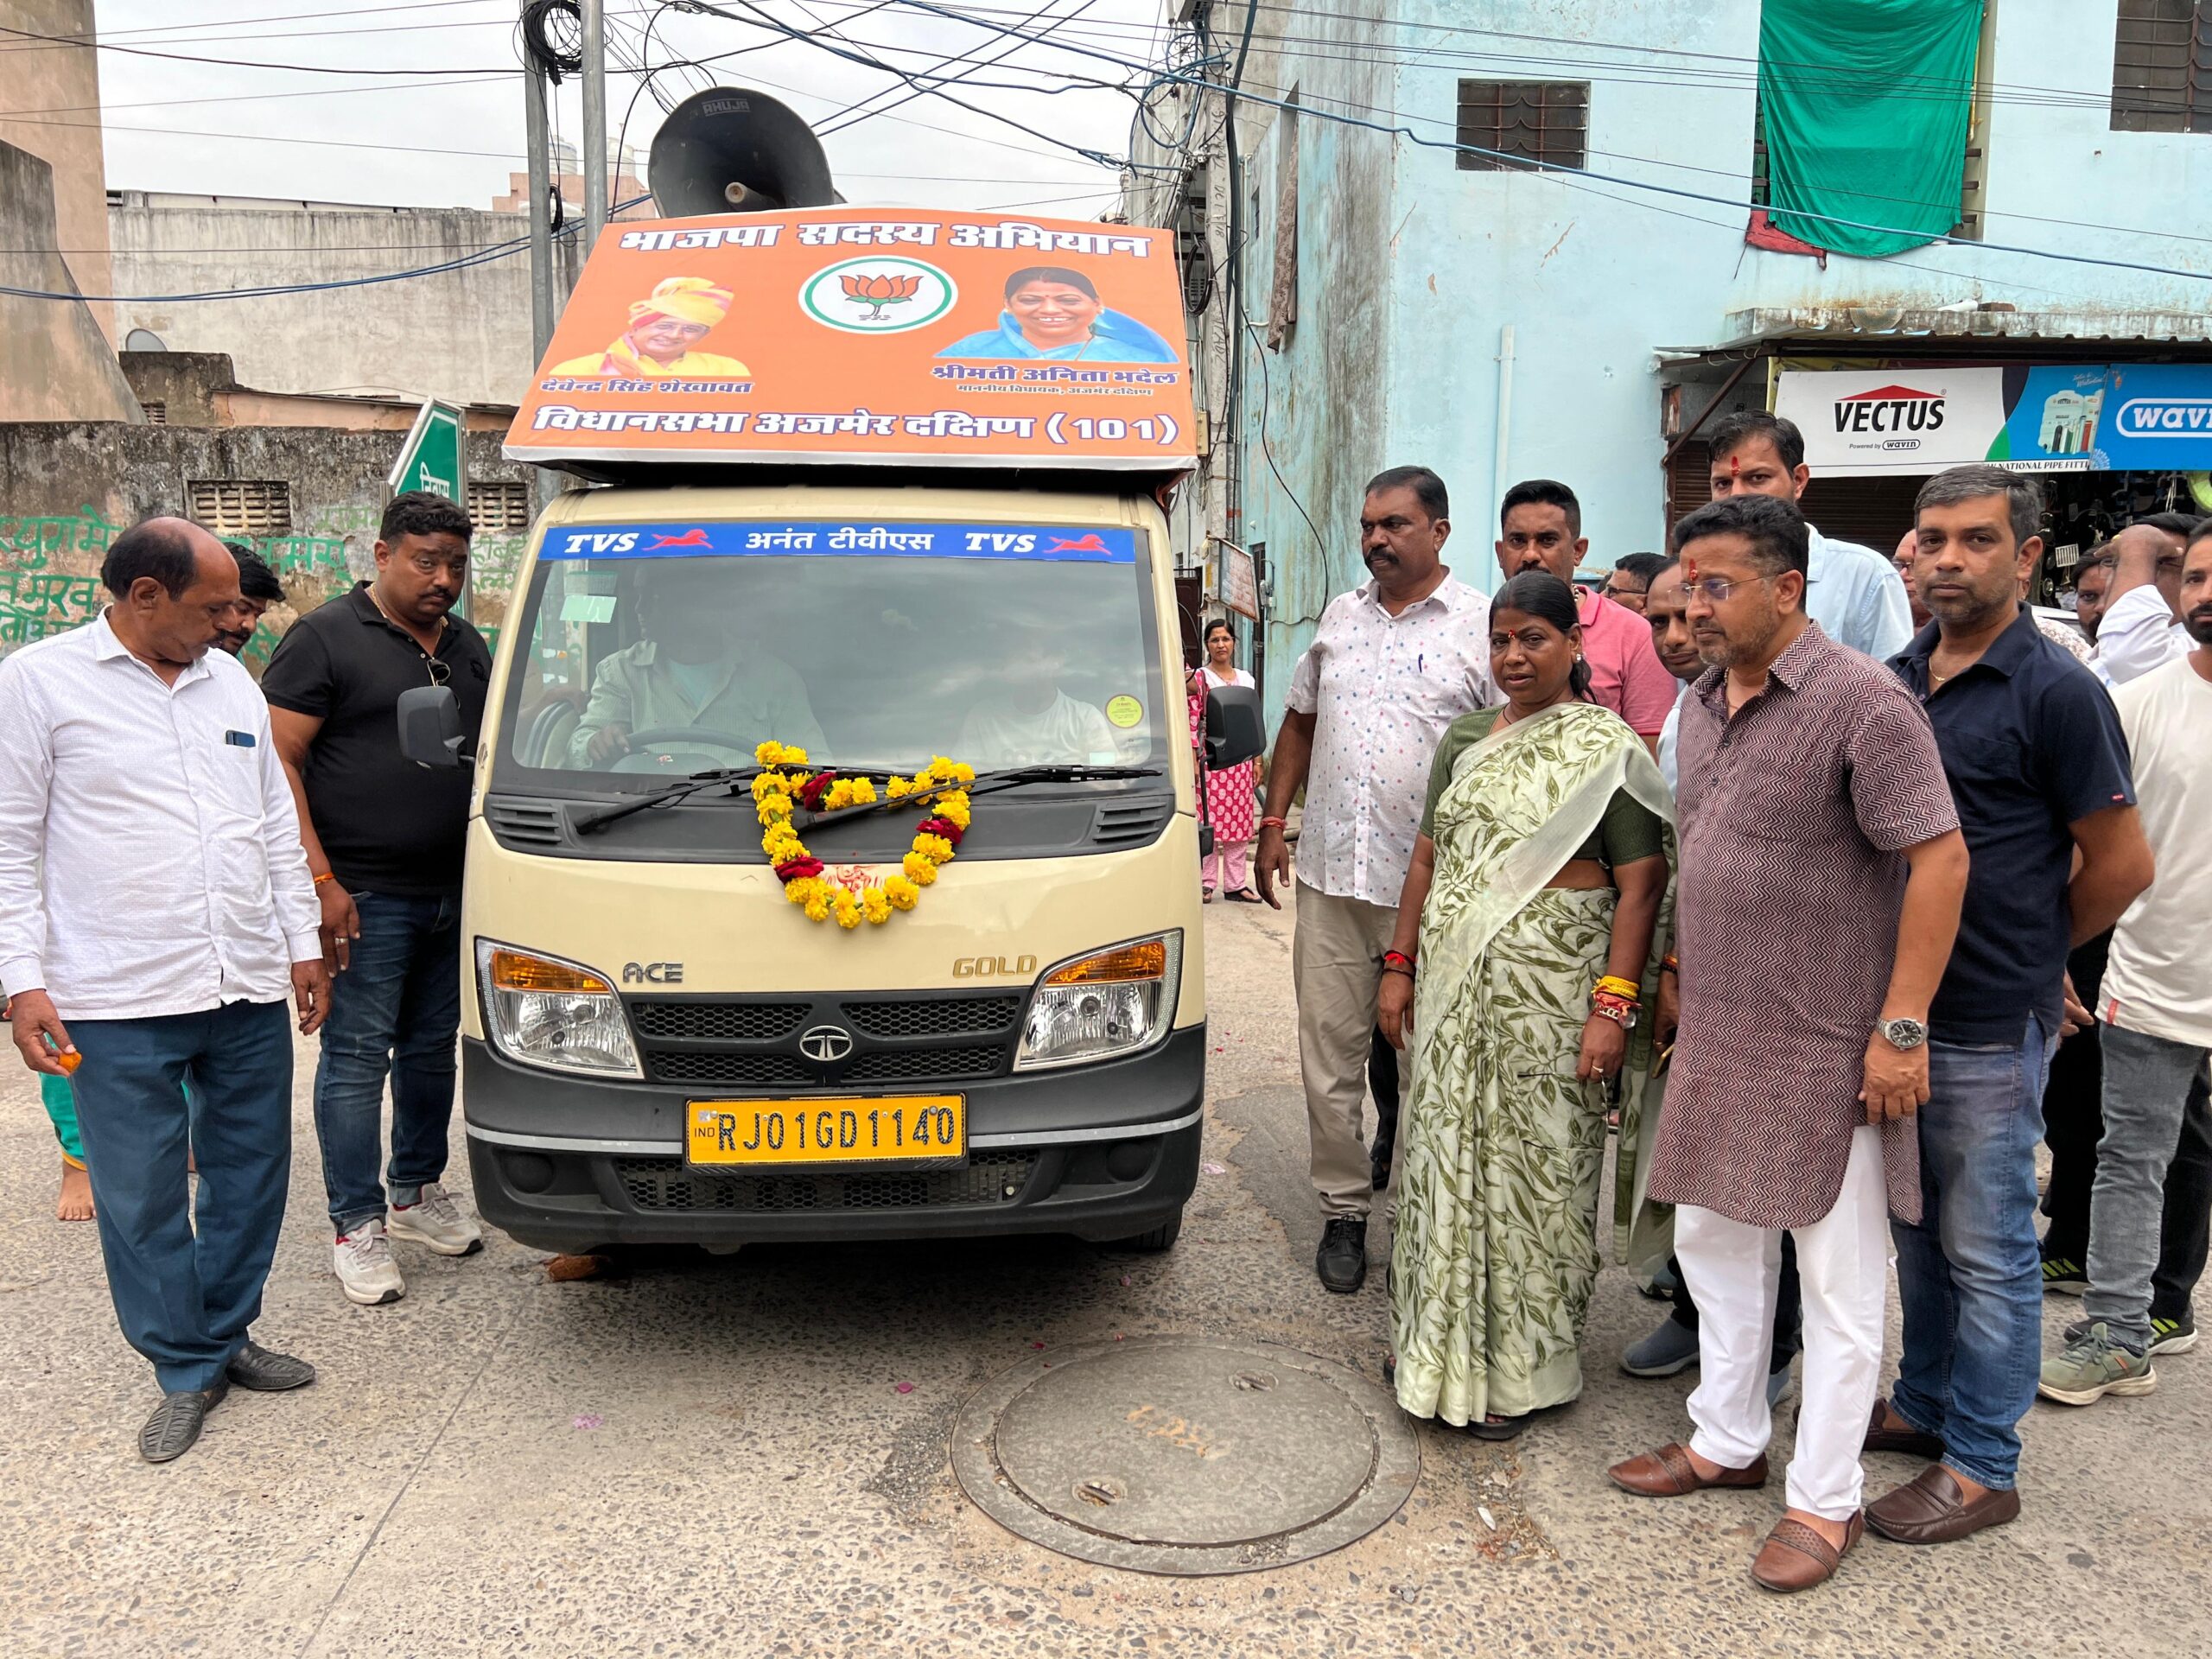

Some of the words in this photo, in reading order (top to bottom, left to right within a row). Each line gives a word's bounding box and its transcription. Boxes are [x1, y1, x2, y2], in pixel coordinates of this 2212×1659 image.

[702, 100, 751, 115] AHUJA
[620, 224, 785, 251] भाजपा
[797, 222, 942, 246] सदस्य
[948, 221, 1153, 257] अभियान
[932, 364, 1018, 381] श्रीमती
[1021, 366, 1109, 383] अनिता
[1113, 369, 1179, 384] भदेल
[541, 378, 603, 393] देवेन्द्र
[607, 378, 654, 392] सिंह
[658, 379, 754, 393] शेखावत
[531, 404, 750, 434] विधानसभा
[753, 408, 899, 435] अजमेर
[902, 410, 1037, 438] दक्षिण
[1045, 412, 1179, 445] (101)
[1834, 399, 1945, 433] VECTUS
[1999, 461, 2042, 471] NATIONAL
[2044, 461, 2063, 469] PIPE
[563, 532, 639, 553] TVS
[745, 527, 817, 550] अनंत
[828, 527, 935, 551] टीवीएस
[965, 532, 1037, 553] TVS
[622, 962, 683, 983] ACE
[952, 955, 1037, 978] GOLD
[695, 1128, 715, 1138] IND
[718, 1106, 955, 1151] RJ01GD1140
